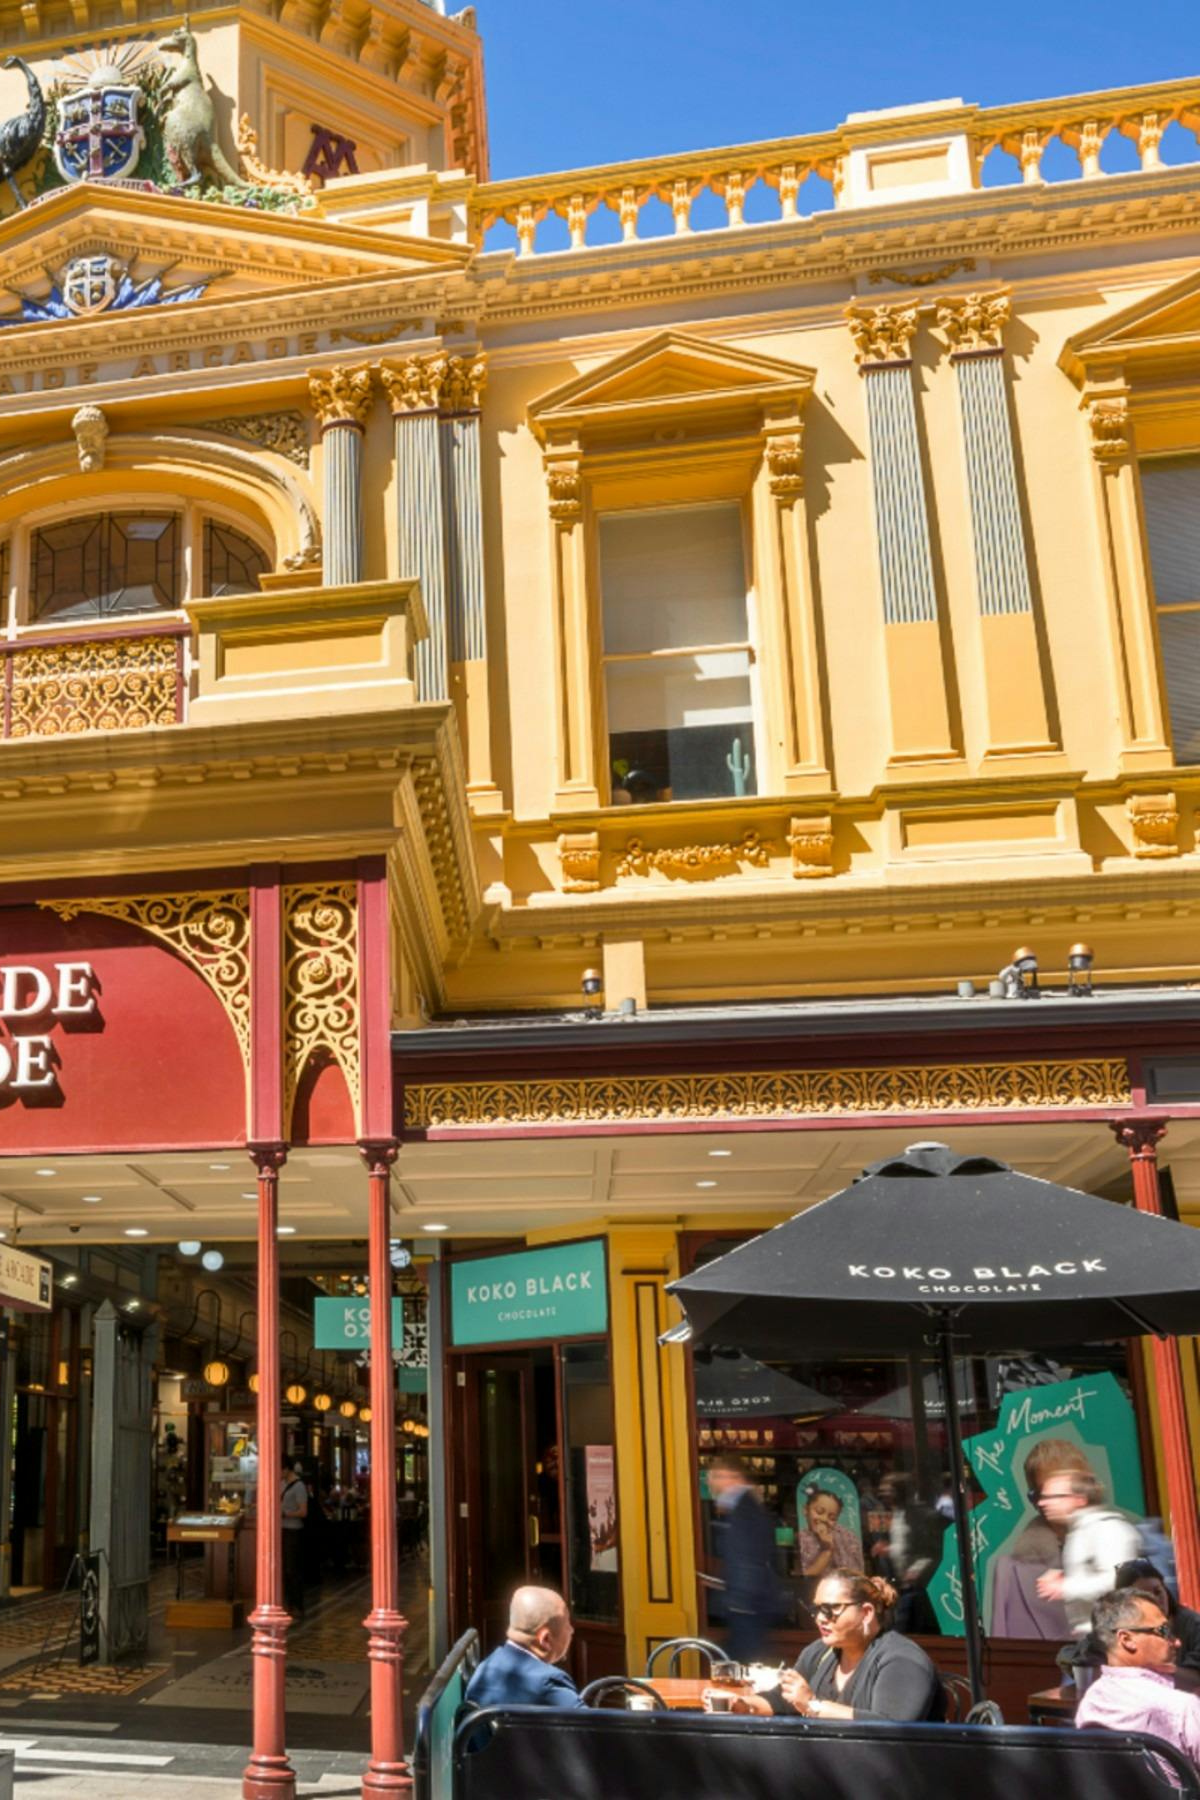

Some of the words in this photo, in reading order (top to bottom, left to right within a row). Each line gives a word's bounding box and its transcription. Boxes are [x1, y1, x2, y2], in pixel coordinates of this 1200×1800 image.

[132, 331, 318, 378] ARCADE
[848, 1264, 952, 1280] KOKO
[972, 1258, 1107, 1279] BLACK
[467, 1281, 517, 1304] KOKO
[526, 1270, 592, 1297] BLACK
[918, 1283, 1043, 1293] CHOCOLATE
[497, 1306, 557, 1322] CHOCOLATE
[1006, 1387, 1098, 1434] Moment
